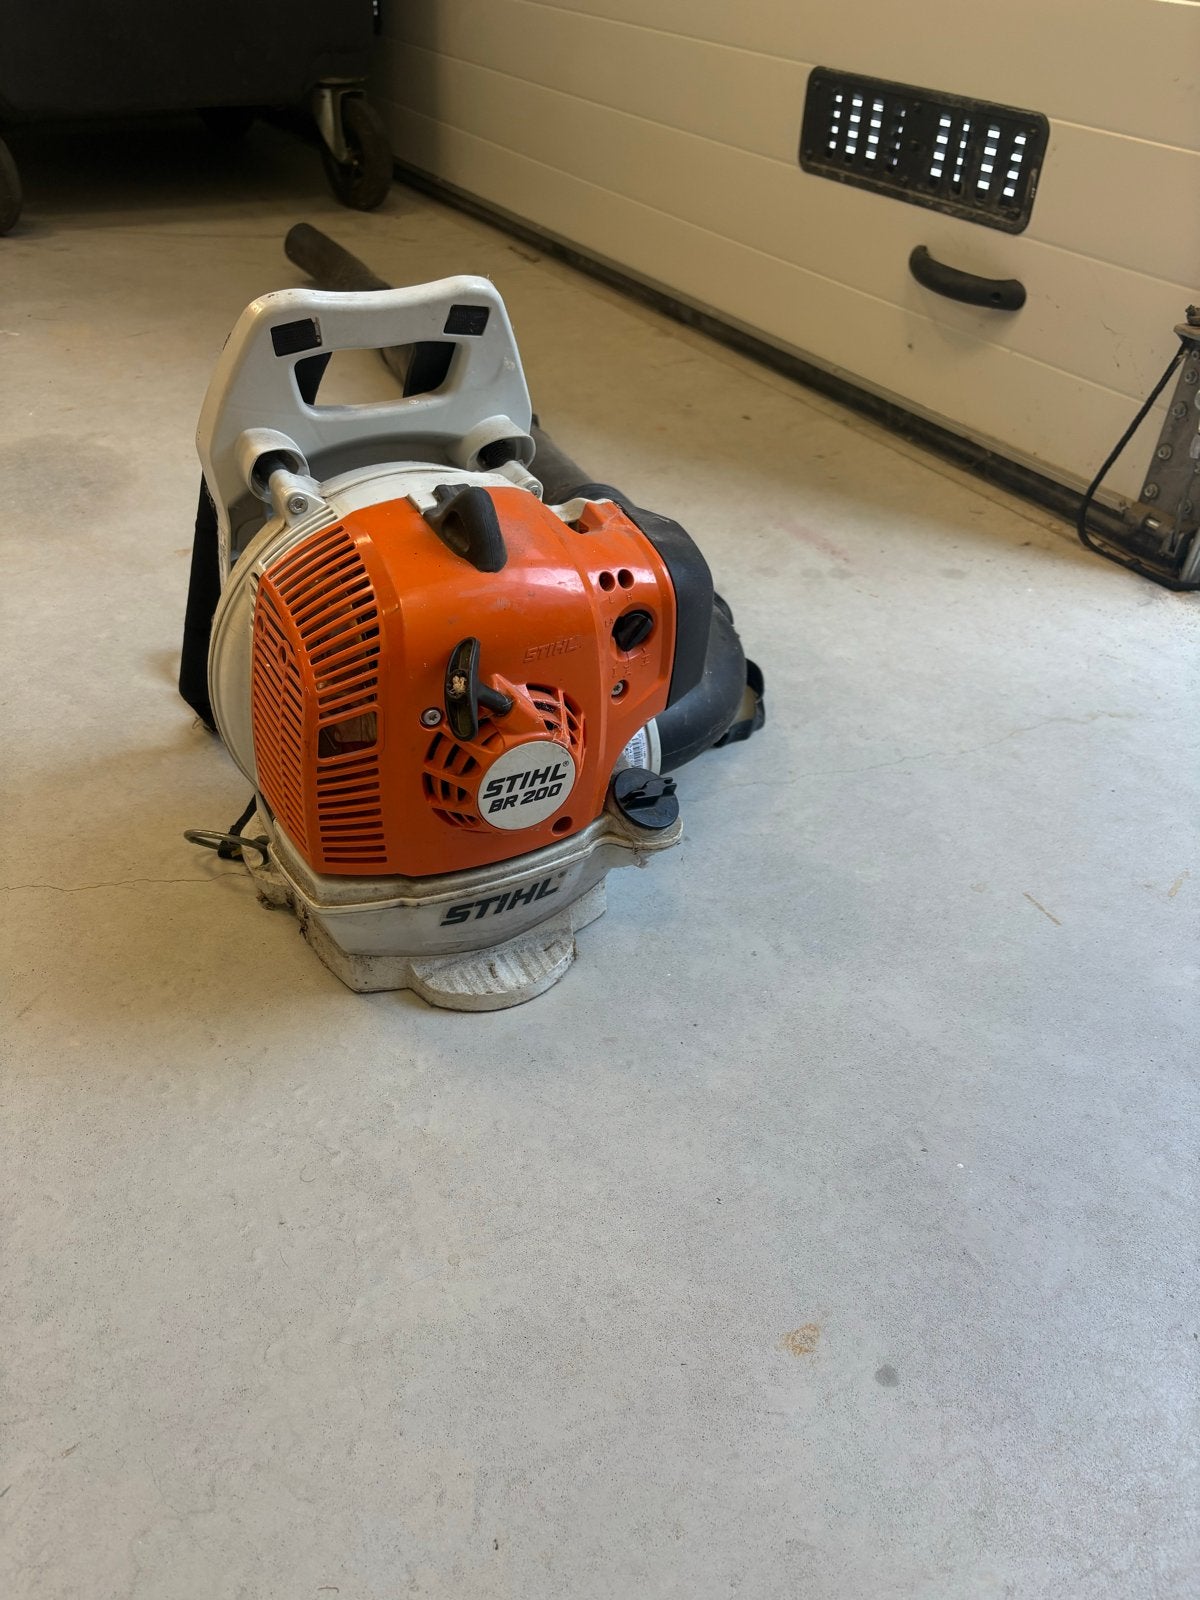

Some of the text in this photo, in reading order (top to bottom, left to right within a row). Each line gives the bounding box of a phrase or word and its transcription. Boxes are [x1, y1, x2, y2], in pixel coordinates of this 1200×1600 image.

[523, 635, 578, 664] STIHL
[488, 782, 563, 814] BR 200
